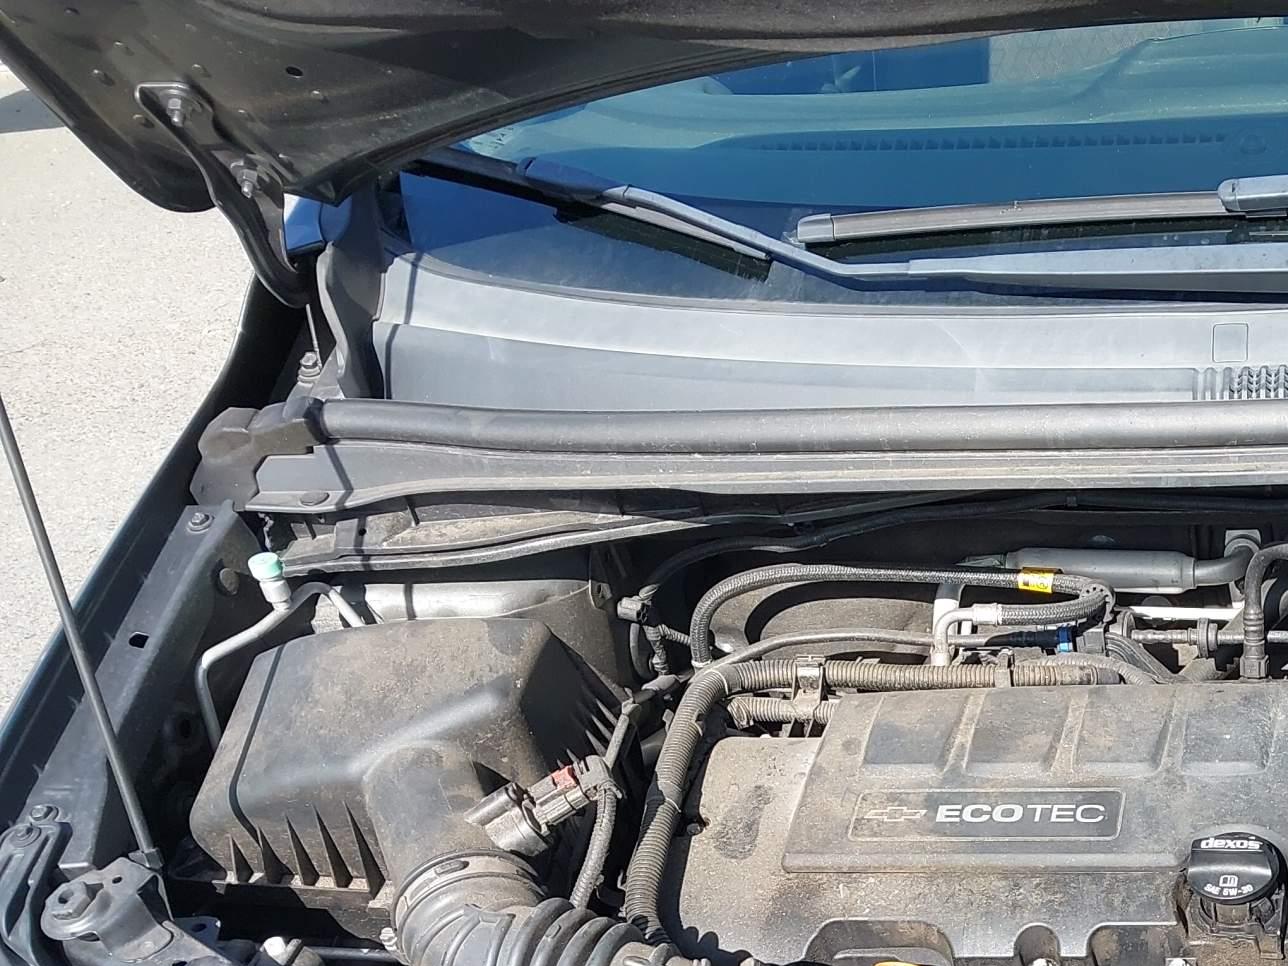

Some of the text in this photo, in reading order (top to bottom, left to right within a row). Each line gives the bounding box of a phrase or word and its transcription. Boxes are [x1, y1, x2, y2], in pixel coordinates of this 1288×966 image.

[935, 804, 1105, 823] ECOTEC
[1200, 837, 1263, 850] dexos
[1203, 883, 1221, 895] SAE
